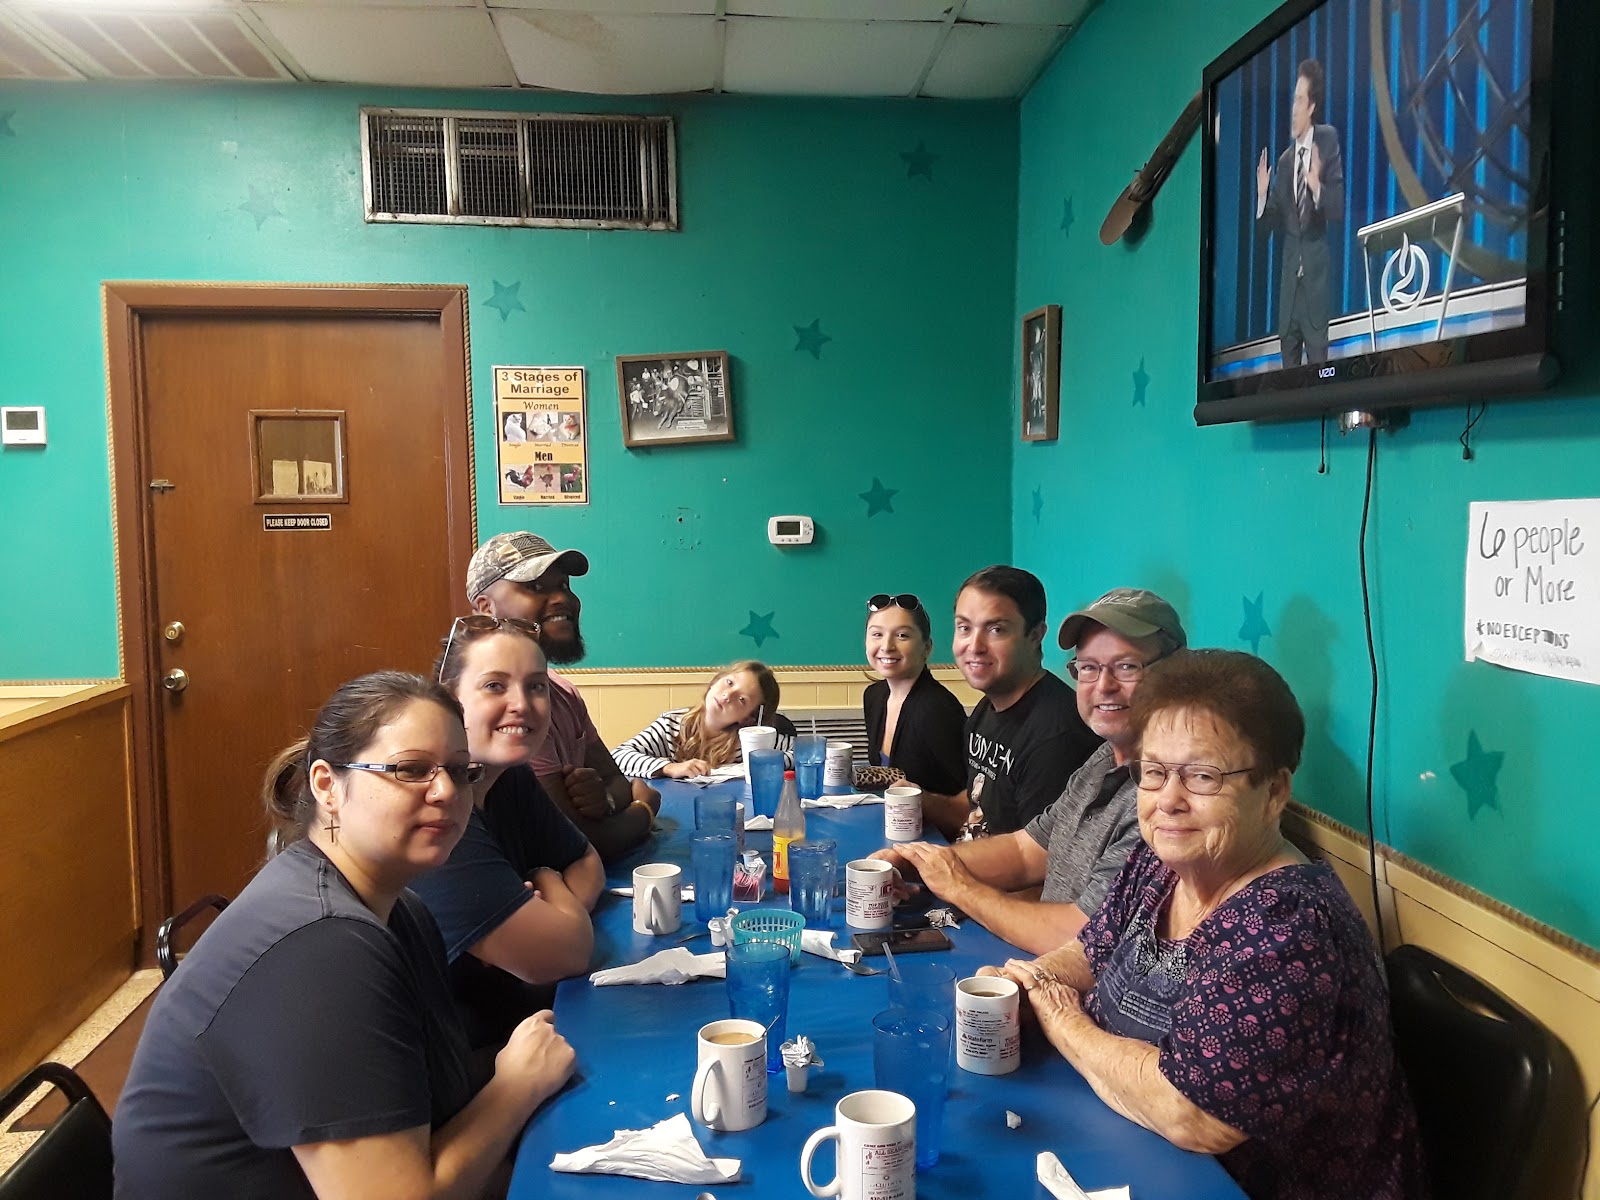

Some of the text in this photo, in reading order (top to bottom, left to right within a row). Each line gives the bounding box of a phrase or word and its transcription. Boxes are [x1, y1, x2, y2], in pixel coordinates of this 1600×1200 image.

[502, 372, 578, 383] 3 Stages of
[510, 384, 570, 396] Marriage
[523, 401, 559, 410] Women
[534, 451, 553, 461] Men
[266, 517, 329, 528] PLEASE KEEP DOOR CLOSED
[1480, 511, 1585, 569] 6 people
[1495, 565, 1576, 605] or More
